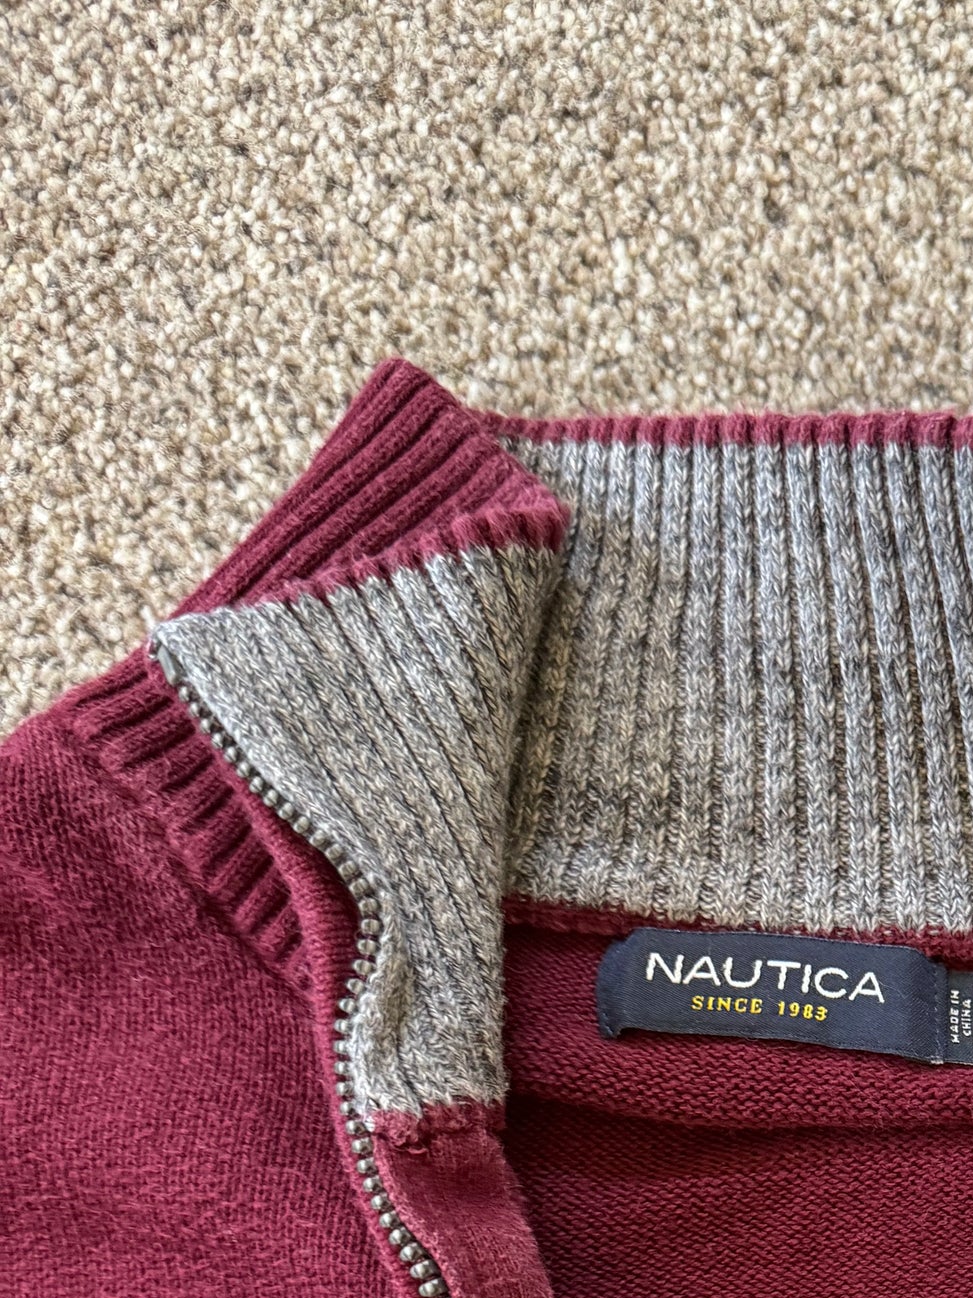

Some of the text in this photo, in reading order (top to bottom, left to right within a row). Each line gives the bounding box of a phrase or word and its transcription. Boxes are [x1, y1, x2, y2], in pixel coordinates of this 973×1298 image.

[645, 952, 885, 1004] NAUTICA
[691, 995, 828, 1021] SINCE 1983
[950, 990, 960, 1043] MADE IN
[961, 999, 972, 1037] CHINA
